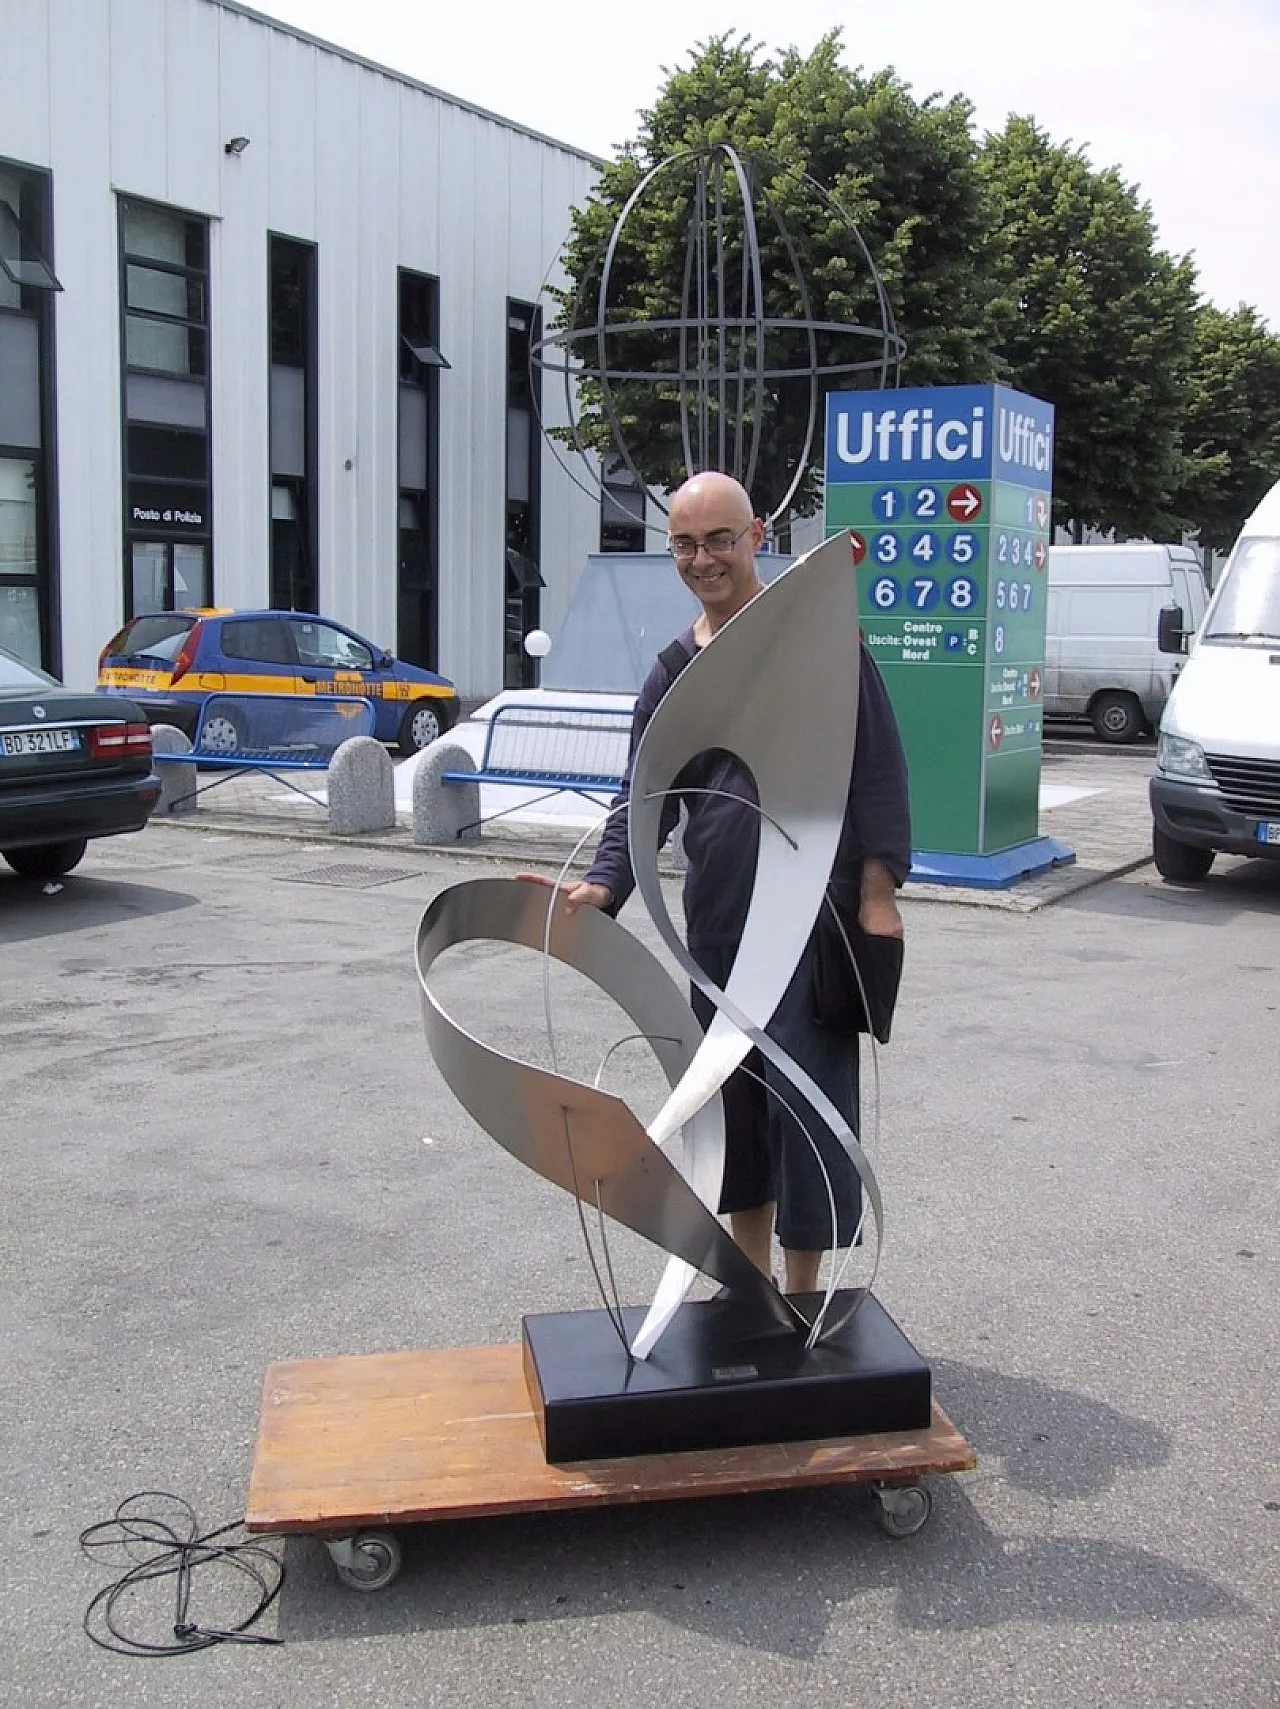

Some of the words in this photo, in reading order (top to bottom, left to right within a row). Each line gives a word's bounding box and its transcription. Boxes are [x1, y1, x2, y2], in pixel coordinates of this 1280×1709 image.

[837, 406, 985, 464] Uffici
[1000, 407, 1050, 471] Uffici
[132, 507, 160, 521] Posto
[162, 509, 172, 521] di
[174, 510, 202, 524] Polizia
[881, 491, 894, 517] 1
[916, 488, 936, 516] 2
[1026, 497, 1034, 523] 1
[877, 534, 897, 562] 3
[912, 534, 933, 561] 4
[953, 535, 973, 562] 5
[998, 534, 1007, 562] 2
[1012, 537, 1020, 564] 3
[1024, 540, 1033, 566] 4
[874, 580, 895, 607] 6
[914, 580, 933, 607] 7
[951, 580, 971, 607] 8
[996, 581, 1006, 608] 5
[1010, 582, 1018, 609] 6
[1022, 583, 1031, 609] 7
[903, 621, 943, 634] Centro
[903, 635, 937, 646] Ovest
[968, 629, 979, 640] B
[994, 626, 1004, 653] 8
[902, 648, 930, 660] Nord
[967, 643, 977, 655] C
